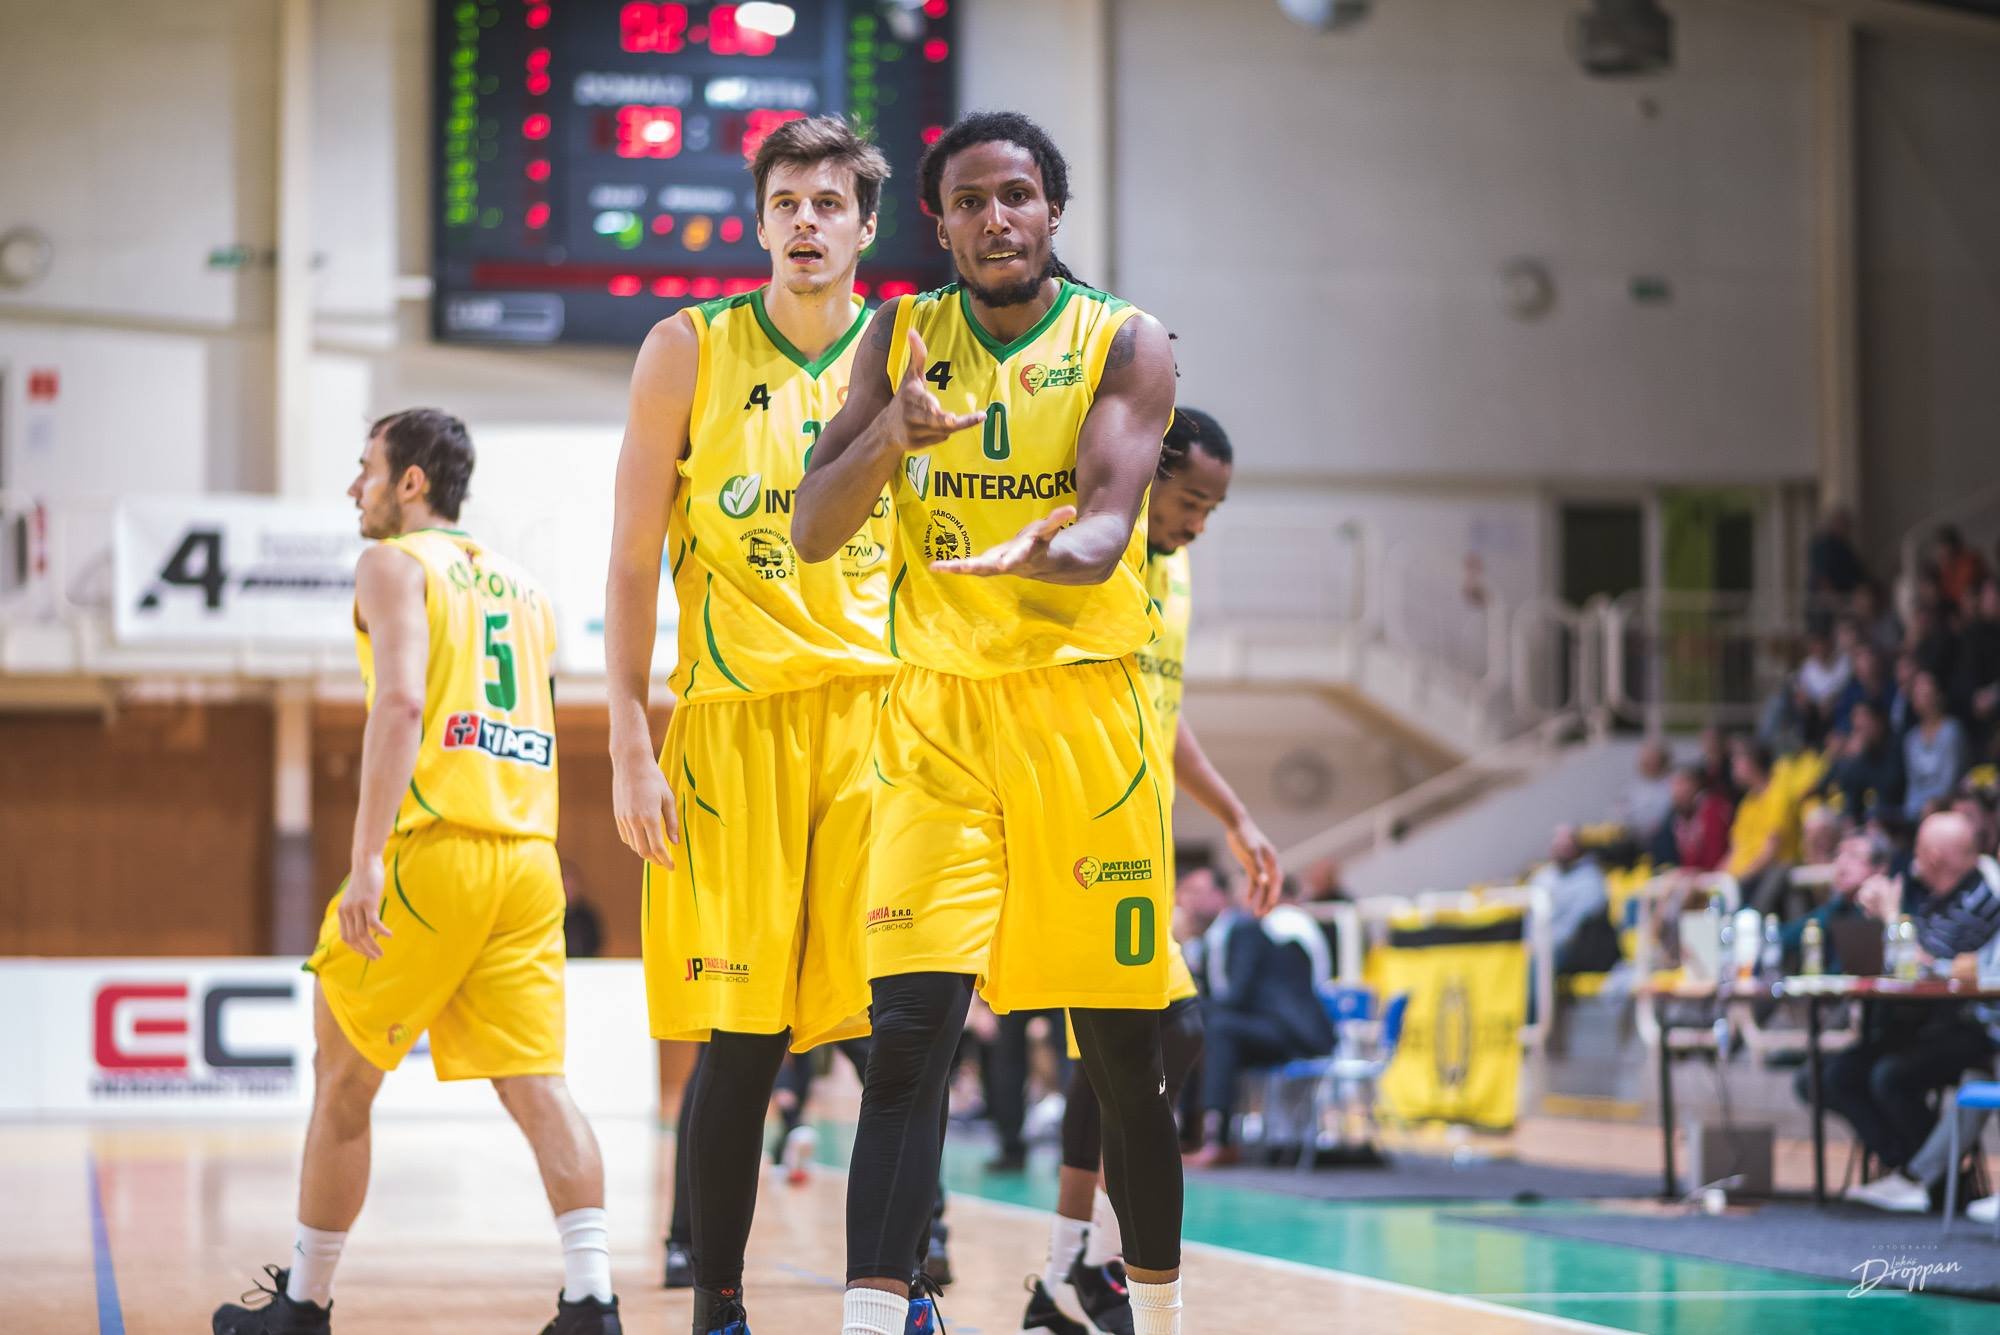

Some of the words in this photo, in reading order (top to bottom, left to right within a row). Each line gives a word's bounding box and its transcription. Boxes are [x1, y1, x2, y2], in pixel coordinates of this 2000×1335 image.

[803, 420, 829, 472] 2
[983, 402, 1011, 460] 0
[934, 470, 1077, 500] INTERAGR
[484, 612, 517, 711] 5
[1102, 859, 1151, 871] PATRIOTI
[1102, 871, 1152, 881] Levice
[1115, 896, 1155, 966] 0
[685, 958, 703, 981] JP
[95, 984, 294, 1068] EC
